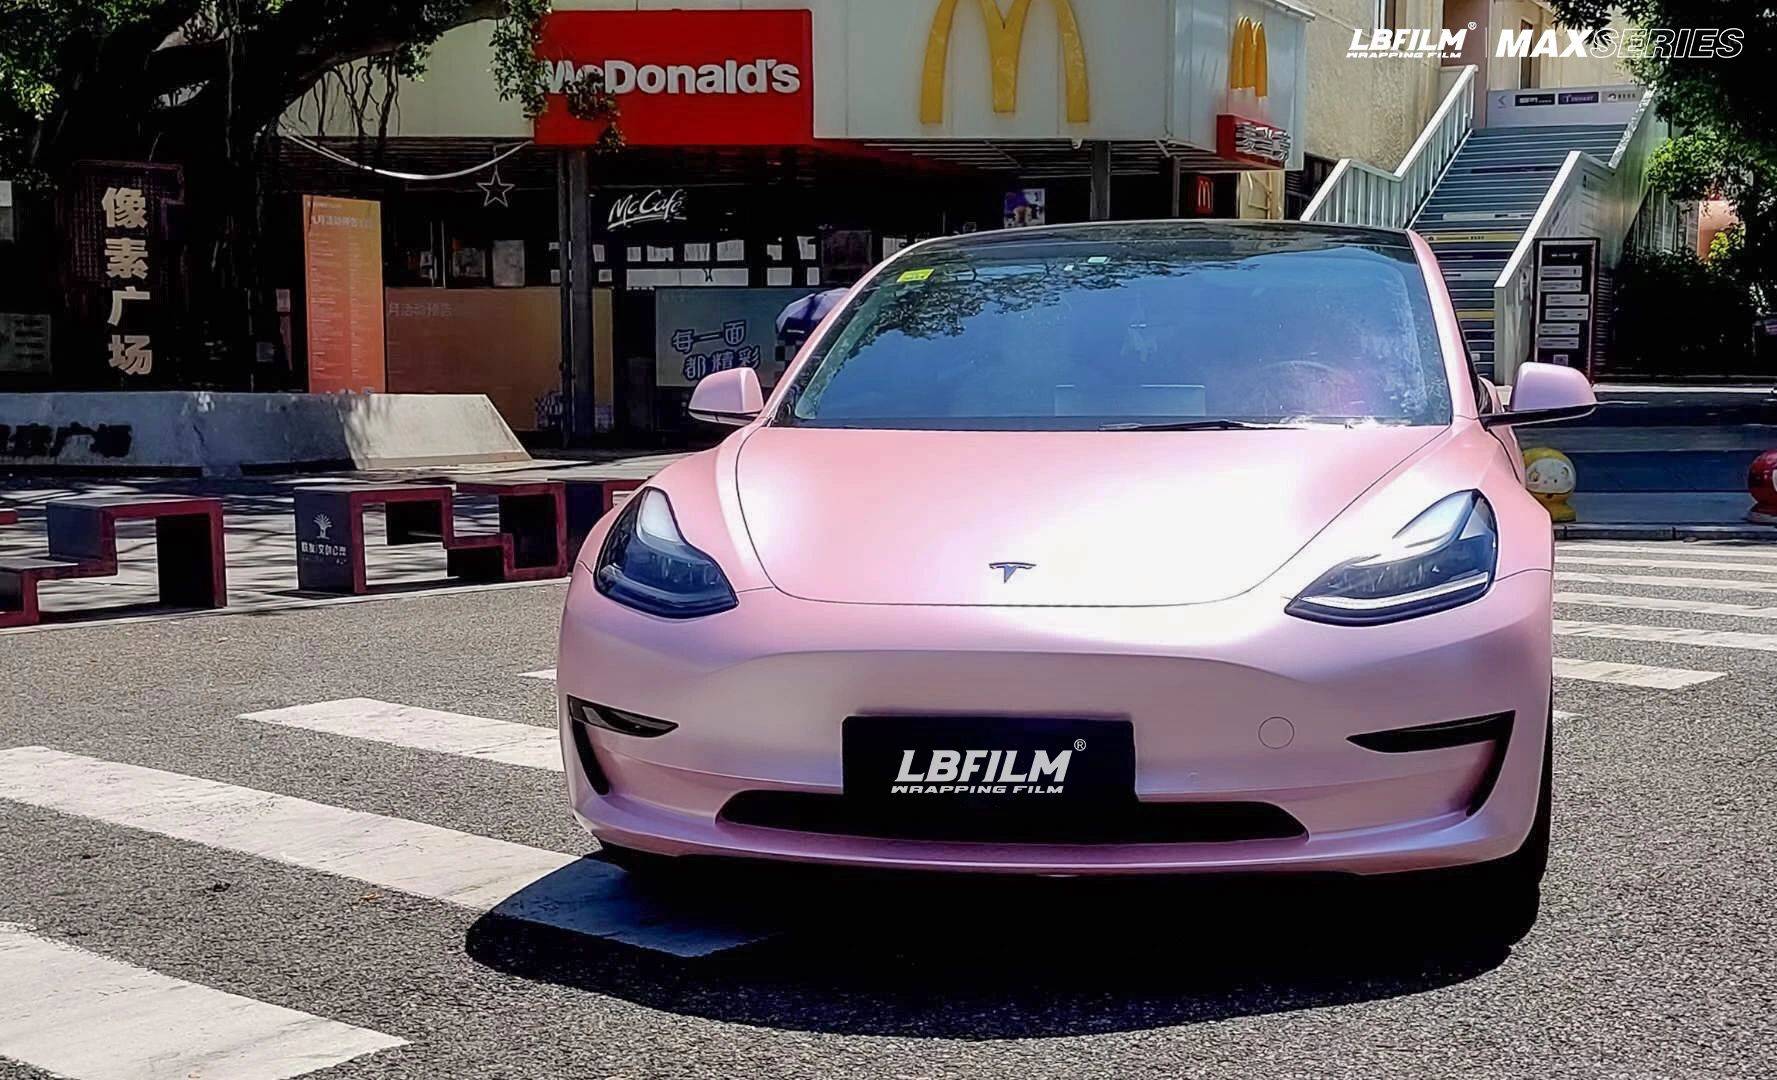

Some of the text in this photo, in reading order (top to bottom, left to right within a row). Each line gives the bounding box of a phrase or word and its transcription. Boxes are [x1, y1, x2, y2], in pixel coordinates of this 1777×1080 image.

[101, 186, 152, 376] 像素广场
[671, 320, 746, 354] 每一面
[683, 346, 761, 380] 都精彩
[891, 785, 1064, 794] WRAPPING FILM
